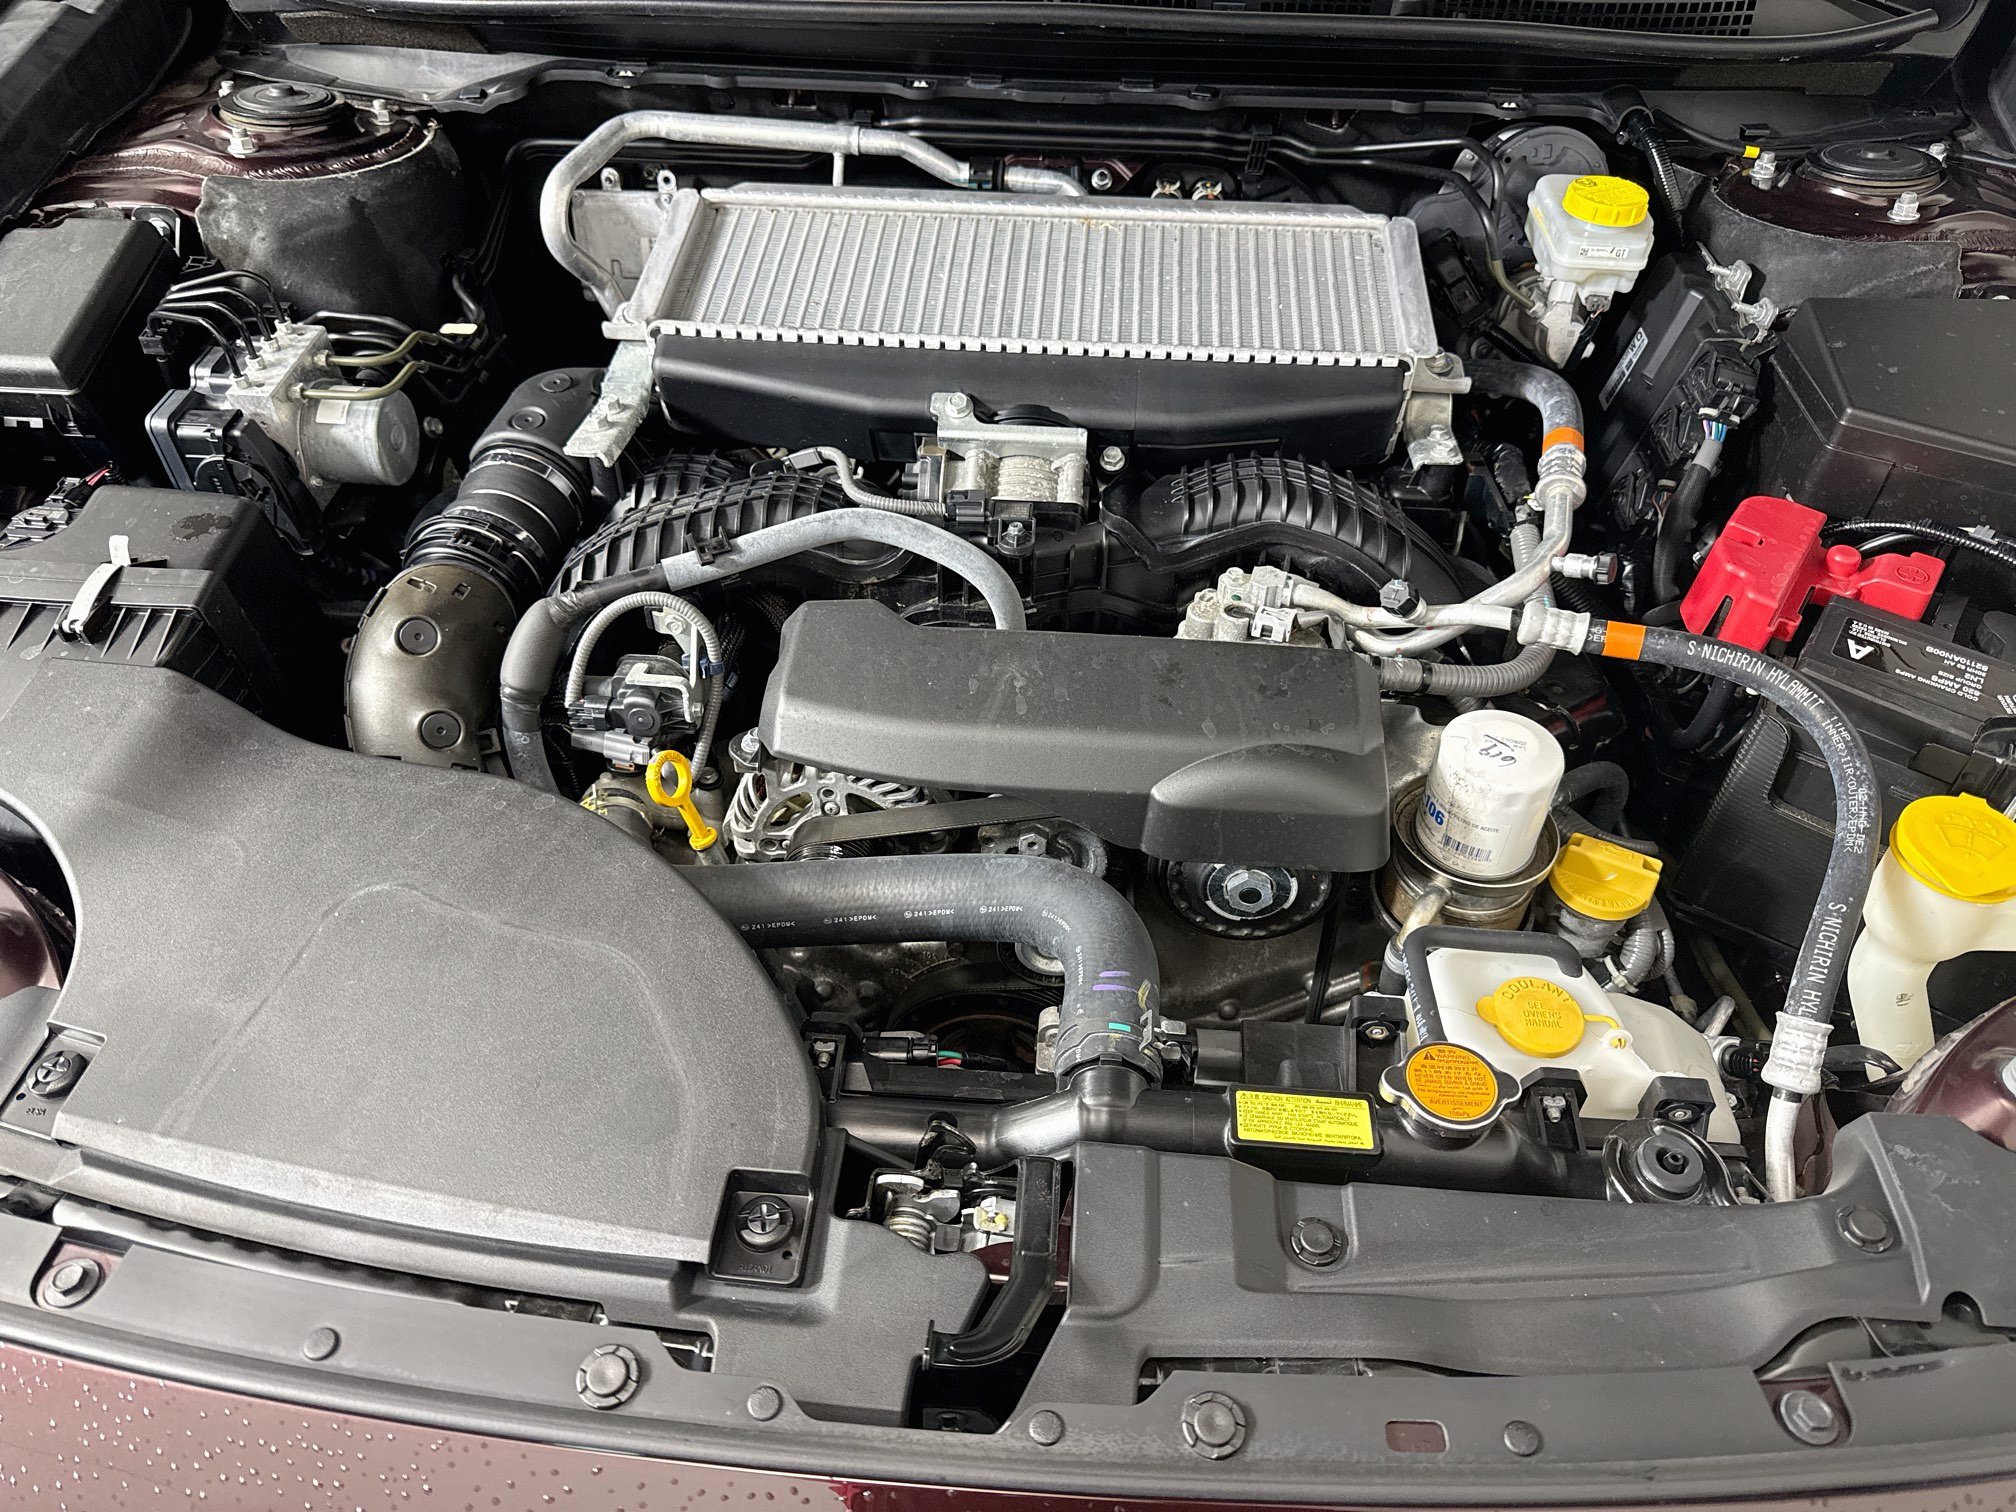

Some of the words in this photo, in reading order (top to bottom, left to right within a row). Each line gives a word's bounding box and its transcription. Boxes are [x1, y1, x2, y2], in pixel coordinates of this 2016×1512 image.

[1615, 249, 1627, 258] GT
[1847, 638, 1875, 660] A
[1894, 667, 1916, 679] AMPS
[1937, 670, 1954, 679] SIZE
[1963, 672, 1984, 684] LN2
[1916, 676, 1957, 693] CRANKING
[1929, 674, 1961, 689] AMPS
[1954, 676, 1982, 689] GROUP
[1766, 665, 1825, 711] HYLAMMIT
[1956, 690, 1979, 702] COLD
[1830, 715, 1851, 741] 11HP
[1480, 825, 1500, 833] ACEITE
[1502, 979, 1573, 1003] COOLANT
[1528, 1001, 1546, 1009] SEE
[1525, 1018, 1564, 1029] MANUAL
[1429, 1098, 1482, 1107] AVERTISSEMENT
